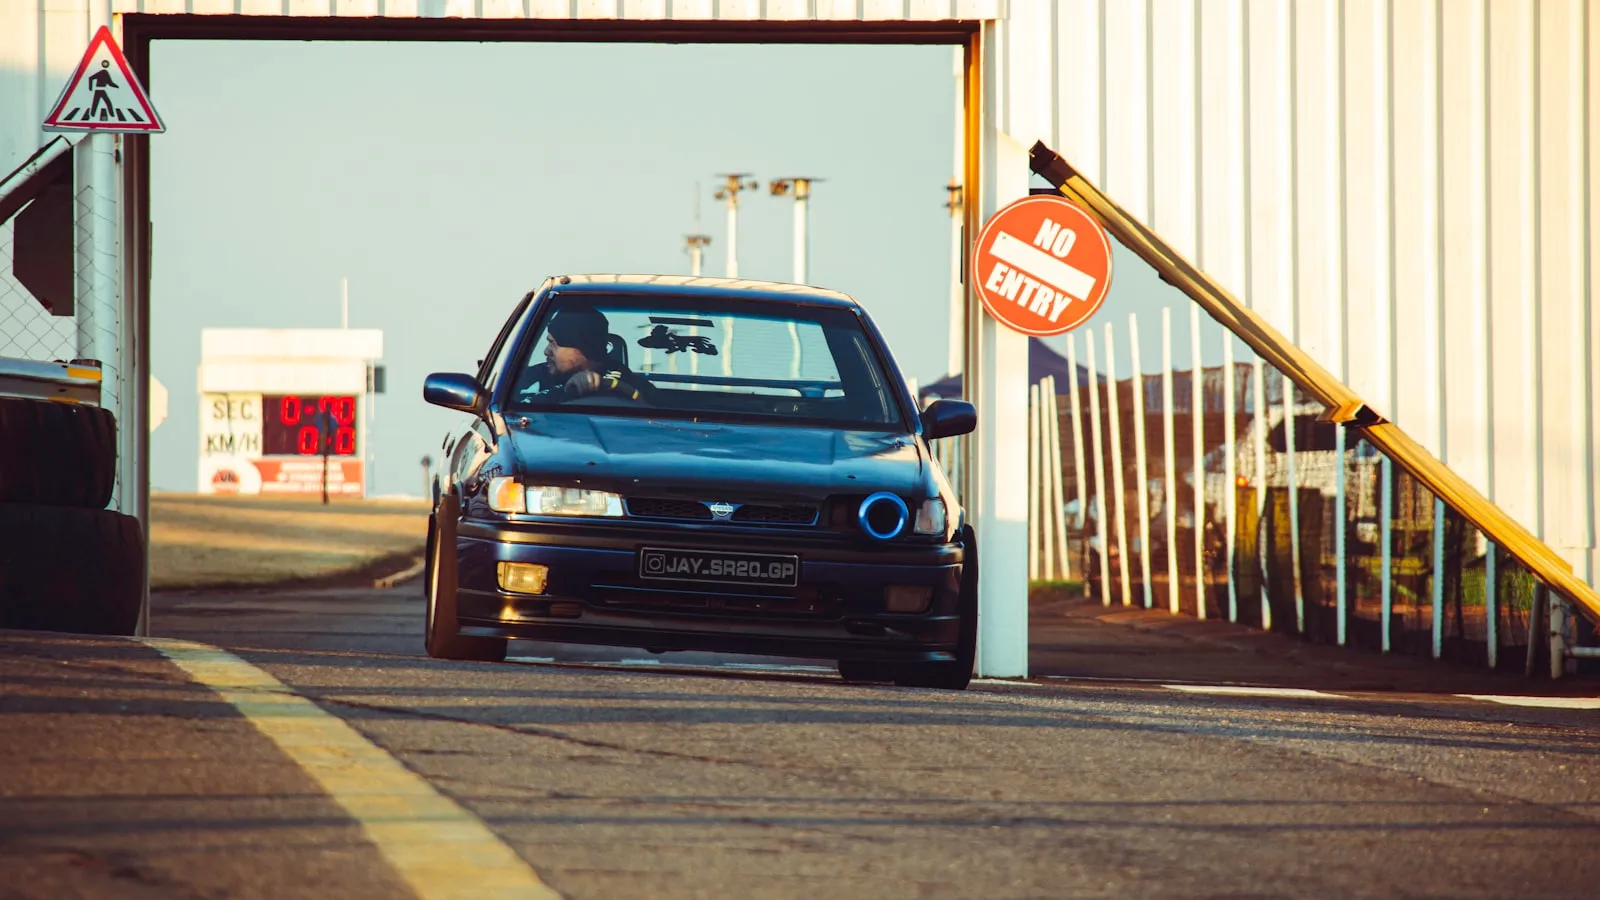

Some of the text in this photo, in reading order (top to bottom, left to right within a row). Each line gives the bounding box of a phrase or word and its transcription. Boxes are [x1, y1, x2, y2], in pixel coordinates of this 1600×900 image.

[1033, 218, 1077, 258] NO
[985, 262, 1072, 323] ENTRY
[213, 400, 257, 420] SEC.
[207, 432, 258, 452] KM/H
[666, 556, 794, 579] JAY_SR20_GP
